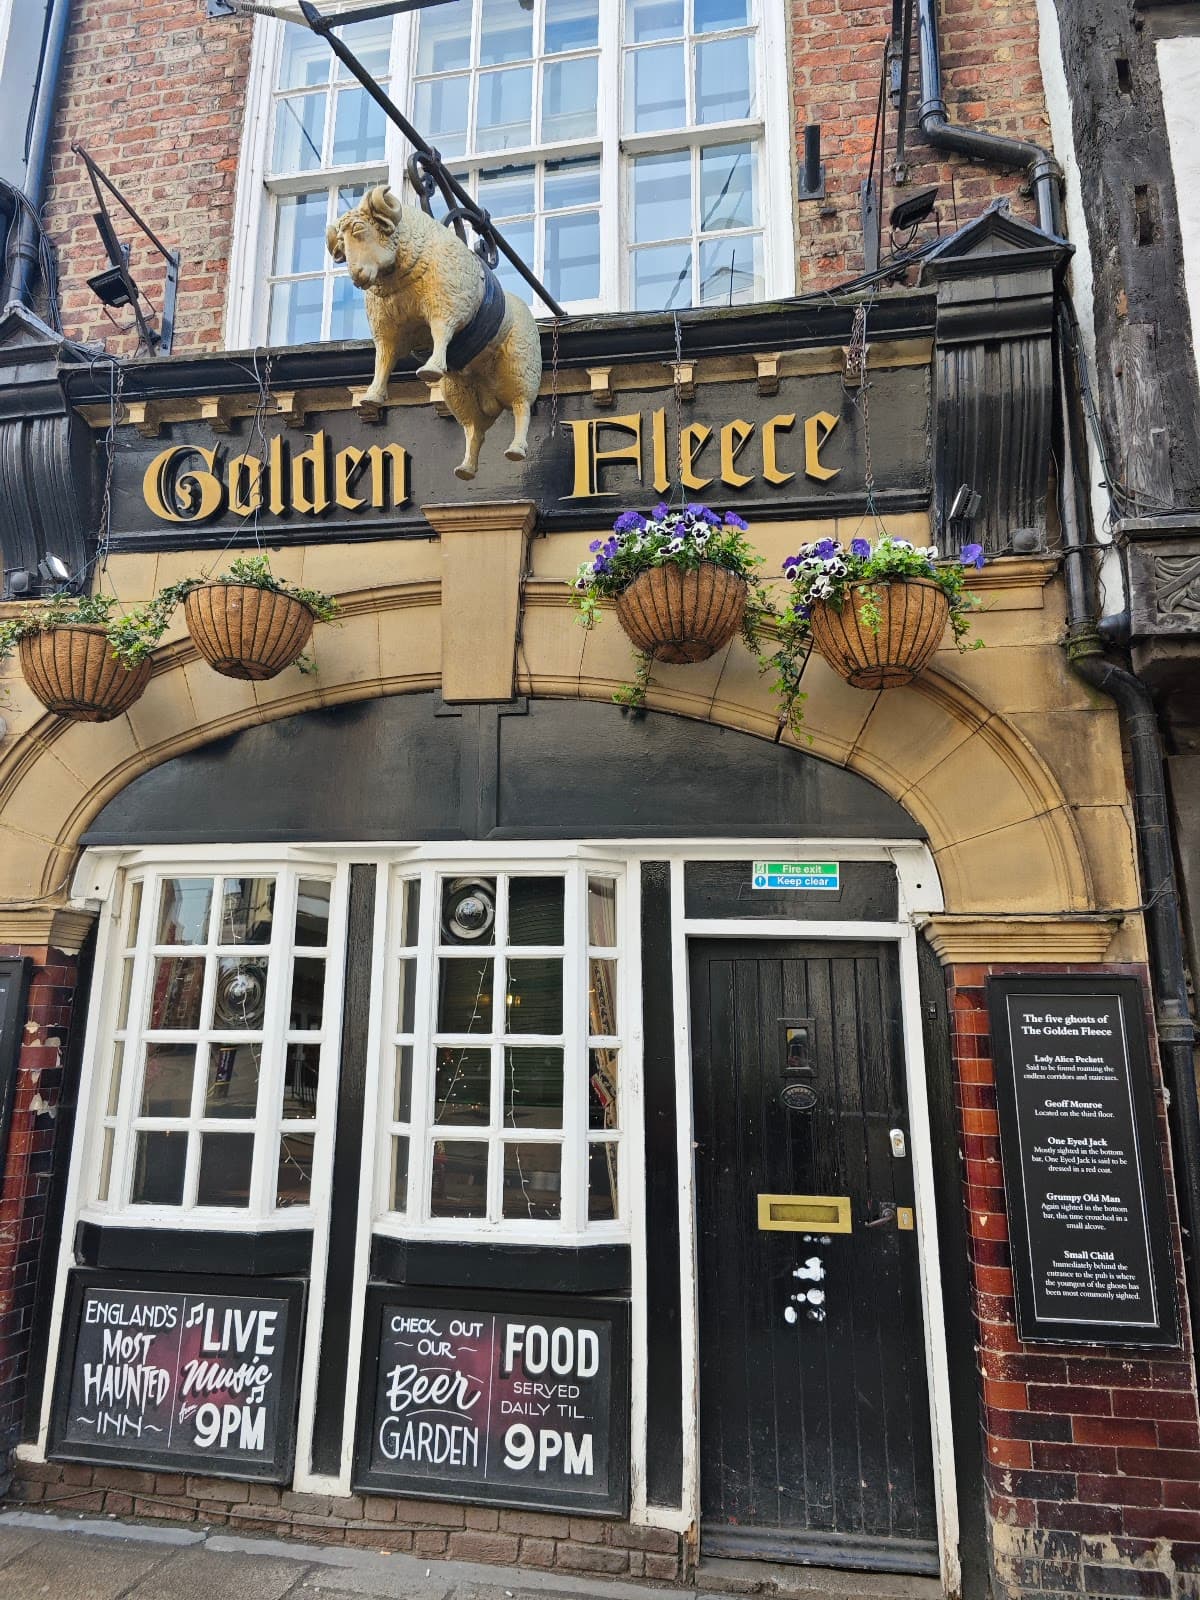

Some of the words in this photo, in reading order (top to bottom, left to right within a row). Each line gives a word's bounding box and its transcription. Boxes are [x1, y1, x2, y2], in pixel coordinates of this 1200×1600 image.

[143, 428, 409, 522] Golden
[558, 406, 842, 501] Fleece
[782, 865, 801, 873] Fire
[803, 865, 822, 873] exit
[777, 876, 802, 887] Keep
[805, 877, 829, 886] clear
[1023, 1014, 1043, 1023] The
[1045, 1014, 1063, 1023] five
[1065, 1015, 1096, 1025] ghosts
[1097, 1015, 1109, 1024] of
[1021, 1026, 1041, 1035] The
[1043, 1026, 1079, 1035] Golden
[1080, 1027, 1112, 1035] Fleece
[1033, 1055, 1054, 1064] Lady
[1076, 1065, 1103, 1073] roaming
[1045, 1100, 1069, 1108] Geoff
[1070, 1100, 1103, 1109] Monroe
[1035, 1109, 1059, 1117] Located
[1048, 1137, 1065, 1145] One
[1067, 1137, 1088, 1147] Eyed
[1089, 1138, 1108, 1147] Jack
[1057, 1147, 1080, 1155] sighted
[1060, 1156, 1075, 1165] Eyed
[1076, 1157, 1091, 1165] Jack
[1046, 1192, 1081, 1203] Grumpy
[1083, 1193, 1099, 1202] Old
[1100, 1194, 1121, 1203] Man
[1041, 1203, 1059, 1211] Again
[1060, 1203, 1083, 1212] sighted
[1092, 1204, 1103, 1212] the
[1104, 1205, 1128, 1213] bottom
[1056, 1212, 1068, 1220] this
[1066, 1222, 1084, 1230] small
[1084, 1222, 1107, 1230] alcove.
[1064, 1250, 1089, 1259] Small
[1090, 1251, 1114, 1260] Child
[1052, 1260, 1092, 1270] Immediately
[1093, 1262, 1116, 1270] behind
[1117, 1263, 1128, 1271] the
[1094, 1272, 1108, 1280] pub
[1095, 1281, 1106, 1289] the
[1106, 1282, 1127, 1290] ghosts
[1080, 1291, 1114, 1299] commonly
[1115, 1292, 1140, 1300] sighted.
[85, 1300, 178, 1328] ENGLAND'S
[203, 1308, 278, 1355] LIVE
[391, 1316, 442, 1336] CHECK
[449, 1320, 484, 1337] OUT
[418, 1339, 456, 1358] OUR
[505, 1323, 598, 1377] FOOD
[181, 1356, 273, 1396] Music
[83, 1363, 170, 1415] HAUNTED
[386, 1364, 482, 1412] Beer
[513, 1382, 580, 1399] SERVED
[501, 1400, 550, 1416] DAILY
[193, 1402, 266, 1450] 9PM
[380, 1416, 479, 1467] GARDEN
[504, 1423, 594, 1476] 9PM
